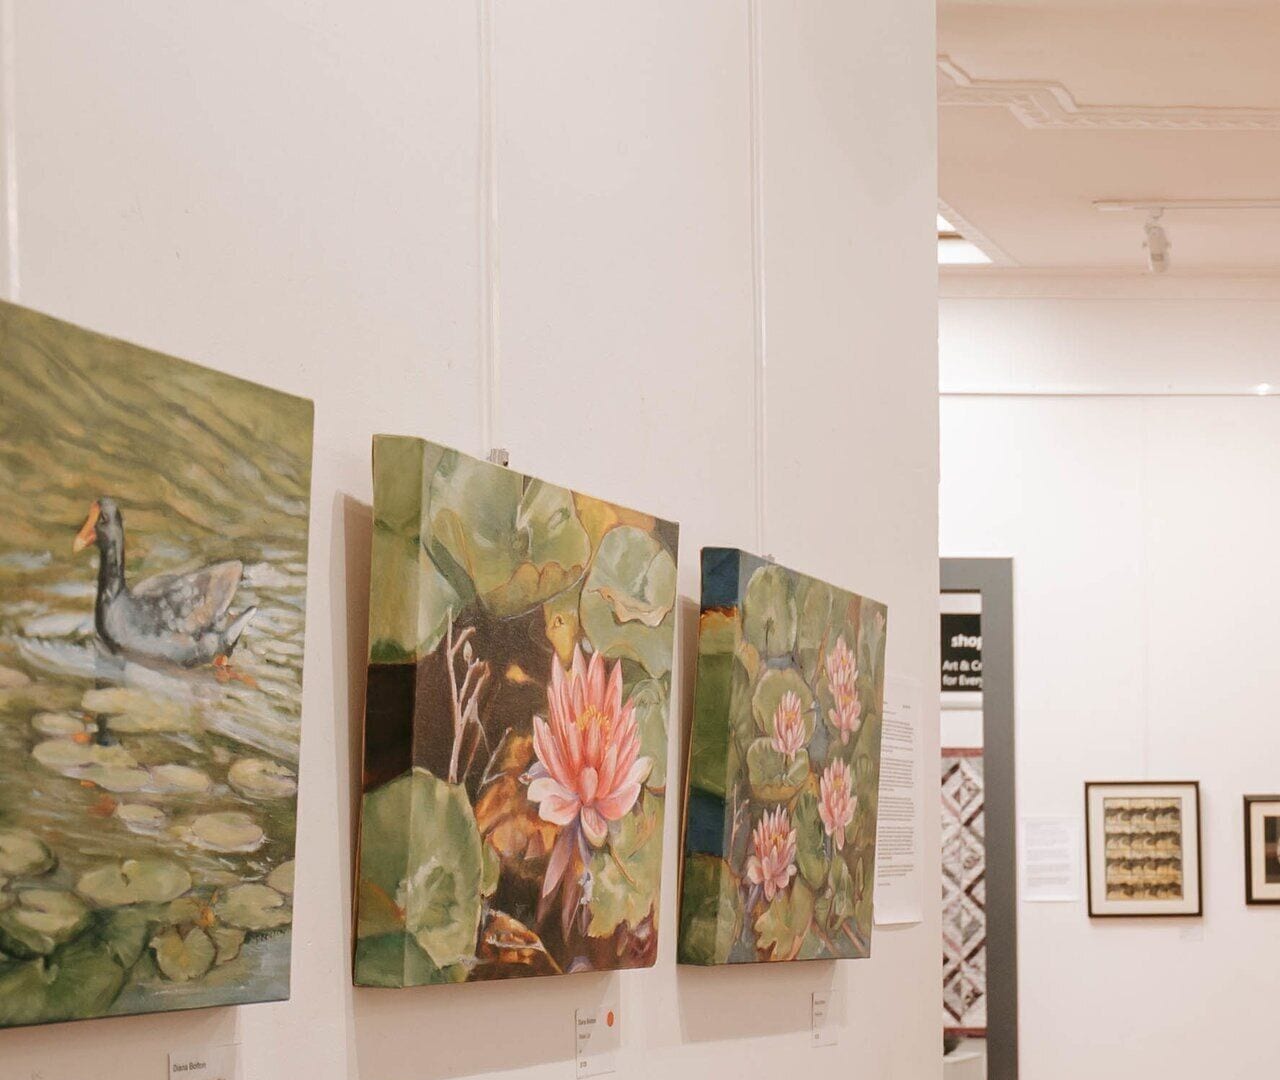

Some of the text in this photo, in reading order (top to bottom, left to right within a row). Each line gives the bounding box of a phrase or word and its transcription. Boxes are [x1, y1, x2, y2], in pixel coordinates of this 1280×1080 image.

[942, 660, 959, 671] Art
[960, 660, 970, 671] &
[942, 674, 958, 686] for
